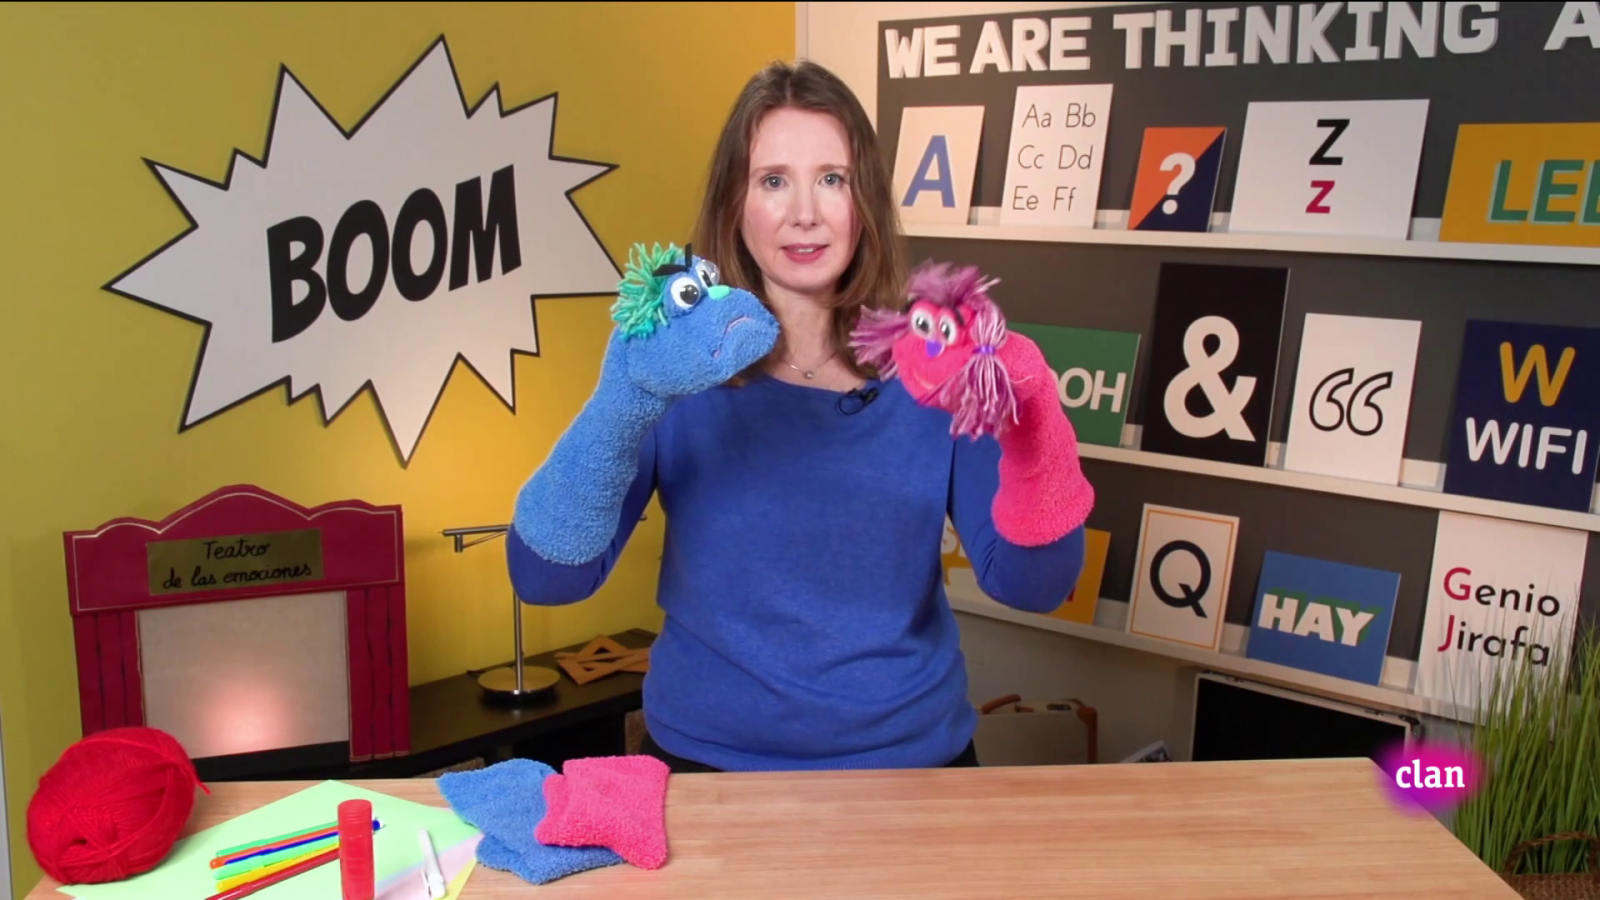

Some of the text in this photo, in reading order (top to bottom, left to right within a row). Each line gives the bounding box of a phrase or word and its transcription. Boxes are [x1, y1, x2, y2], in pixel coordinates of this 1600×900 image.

[884, 25, 961, 78] WE
[969, 17, 1092, 74] ARE
[1113, 2, 1499, 69] THINKING
[1021, 102, 1096, 128] Aa Bb
[1308, 119, 1350, 165] Z
[901, 135, 956, 208] A
[1017, 144, 1093, 169] Cc Dd
[1159, 152, 1196, 215] ?
[1012, 185, 1077, 211] Ee Ff
[266, 164, 522, 343] BOOM
[1163, 315, 1257, 442] &
[1500, 341, 1576, 407] W
[1465, 416, 1588, 475] WIFI
[162, 563, 312, 588] de las emociones
[202, 538, 270, 560] Teatro
[1149, 540, 1209, 618] Q
[1442, 567, 1561, 617] Genio
[1257, 590, 1378, 648] HAY
[1436, 614, 1550, 667] Jirafa
